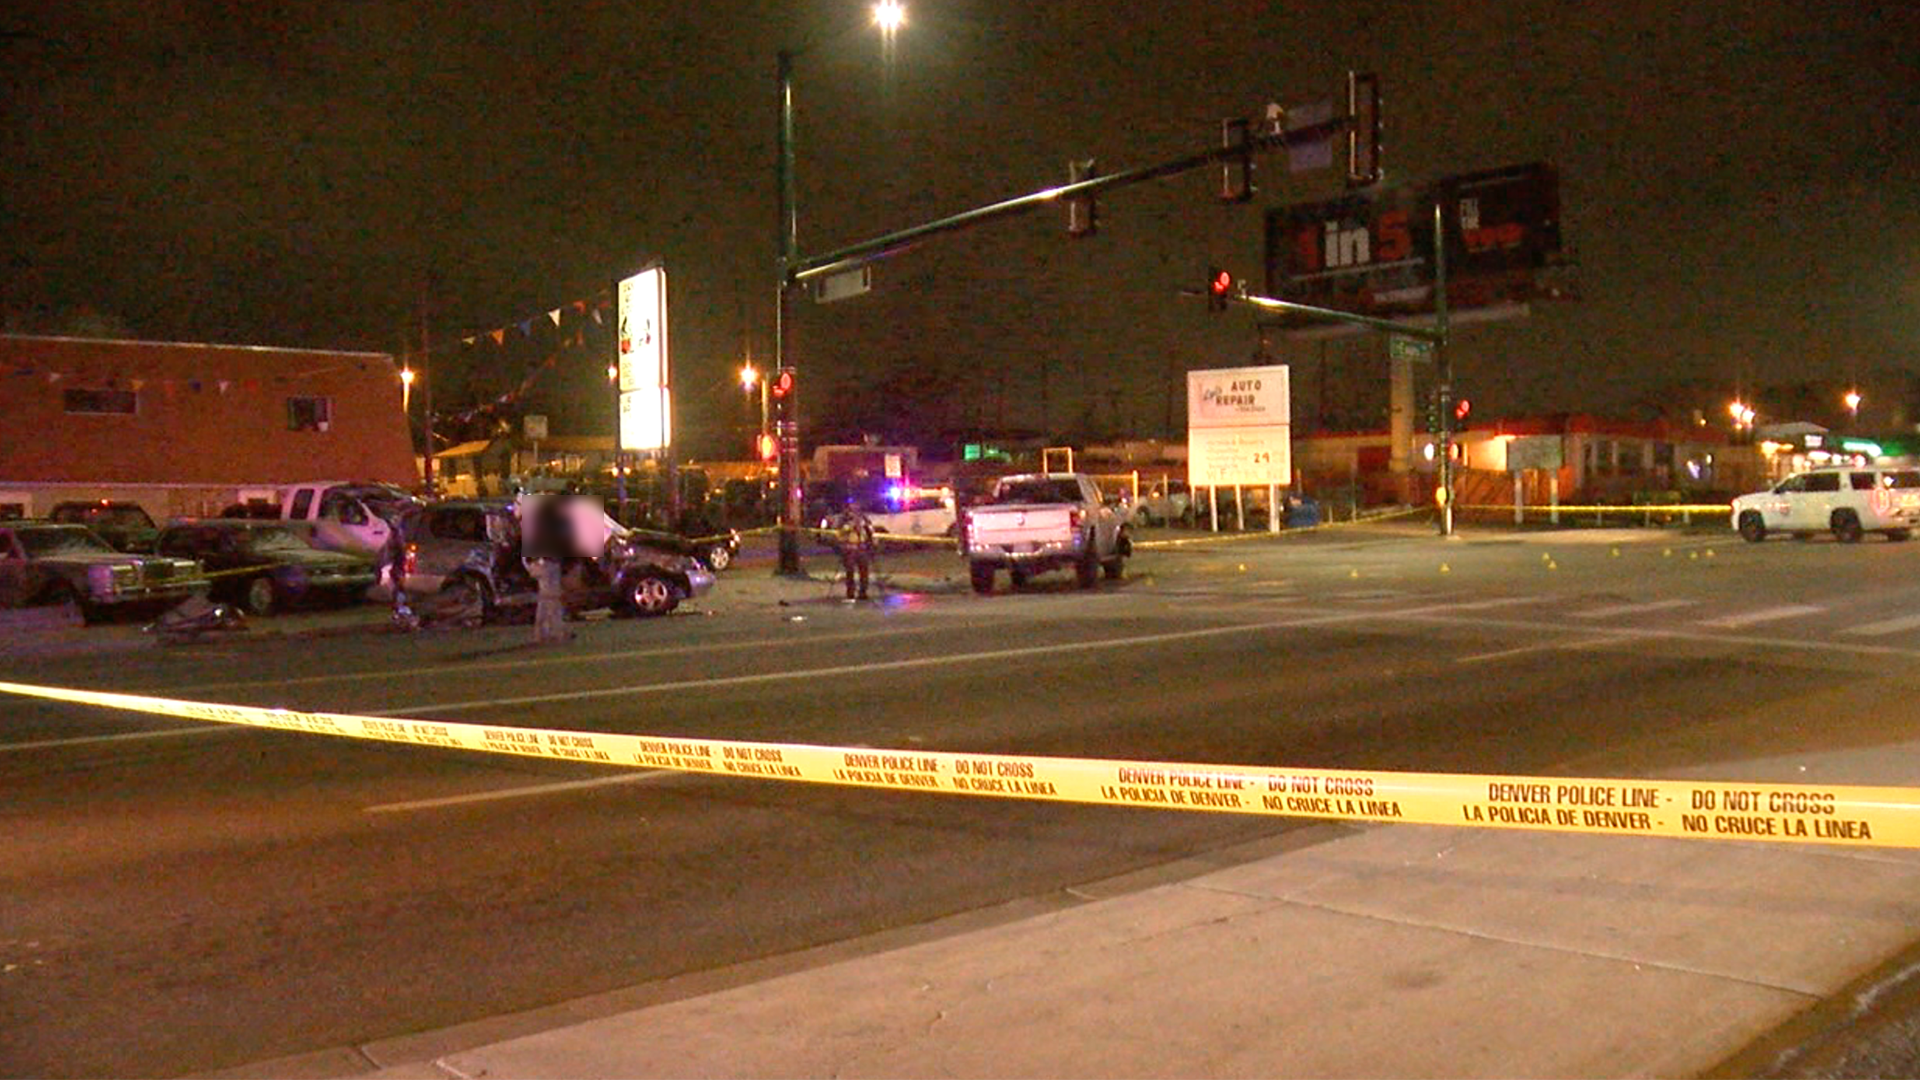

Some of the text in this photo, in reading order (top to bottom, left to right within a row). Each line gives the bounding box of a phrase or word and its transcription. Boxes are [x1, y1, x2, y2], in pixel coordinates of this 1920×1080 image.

[1325, 221, 1370, 268] in
[1380, 211, 1411, 258] 5
[1216, 394, 1255, 405] REPAIR
[1231, 380, 1261, 391] AUTO
[640, 741, 668, 753] DENVER
[668, 743, 694, 756] POLICE
[723, 746, 734, 759] DO
[736, 747, 753, 760] NOT
[755, 748, 782, 762] CROSS
[844, 753, 880, 769] DENVER
[882, 756, 915, 771] POLICE
[917, 757, 939, 772] LINE
[955, 759, 969, 774] DO
[973, 760, 993, 776] NOT
[997, 762, 1034, 778] CROSS
[833, 768, 847, 781] LA
[847, 770, 884, 783] POLICIA
[884, 772, 898, 784] DE
[899, 773, 939, 788] DENVER
[952, 777, 969, 789] NO
[970, 778, 1006, 792] CRUCE
[1007, 780, 1023, 793] LA
[1023, 781, 1058, 795] LINEA
[1118, 767, 1165, 785] DENVER
[1169, 769, 1212, 788] POLICE
[1216, 772, 1246, 790] LINE
[1268, 774, 1286, 792] DO
[1291, 775, 1320, 794] NOT
[1325, 776, 1374, 796] CROSS
[1101, 785, 1118, 800] LA
[1120, 787, 1168, 803] POLICIA
[1170, 790, 1187, 804] DE
[1190, 791, 1242, 808] DENVER
[1262, 795, 1283, 810] NO
[1287, 796, 1333, 814] CRUCE
[1336, 799, 1356, 815] LA
[1358, 800, 1403, 817] LINEA
[1489, 783, 1550, 804] DENVER
[1557, 785, 1616, 807] POLICE
[1622, 788, 1659, 808] LINE
[1692, 790, 1716, 811] DO
[1724, 791, 1762, 812] NOT
[1769, 792, 1836, 815] CROSS
[1463, 805, 1484, 822] LA
[1488, 806, 1552, 825] POLICIA
[1556, 809, 1579, 826] DE
[1583, 811, 1652, 830] DENVER
[1682, 814, 1709, 833] NO
[1715, 816, 1778, 836] CRUCE
[1784, 818, 1808, 837] LA
[1814, 819, 1872, 840] LINEA
